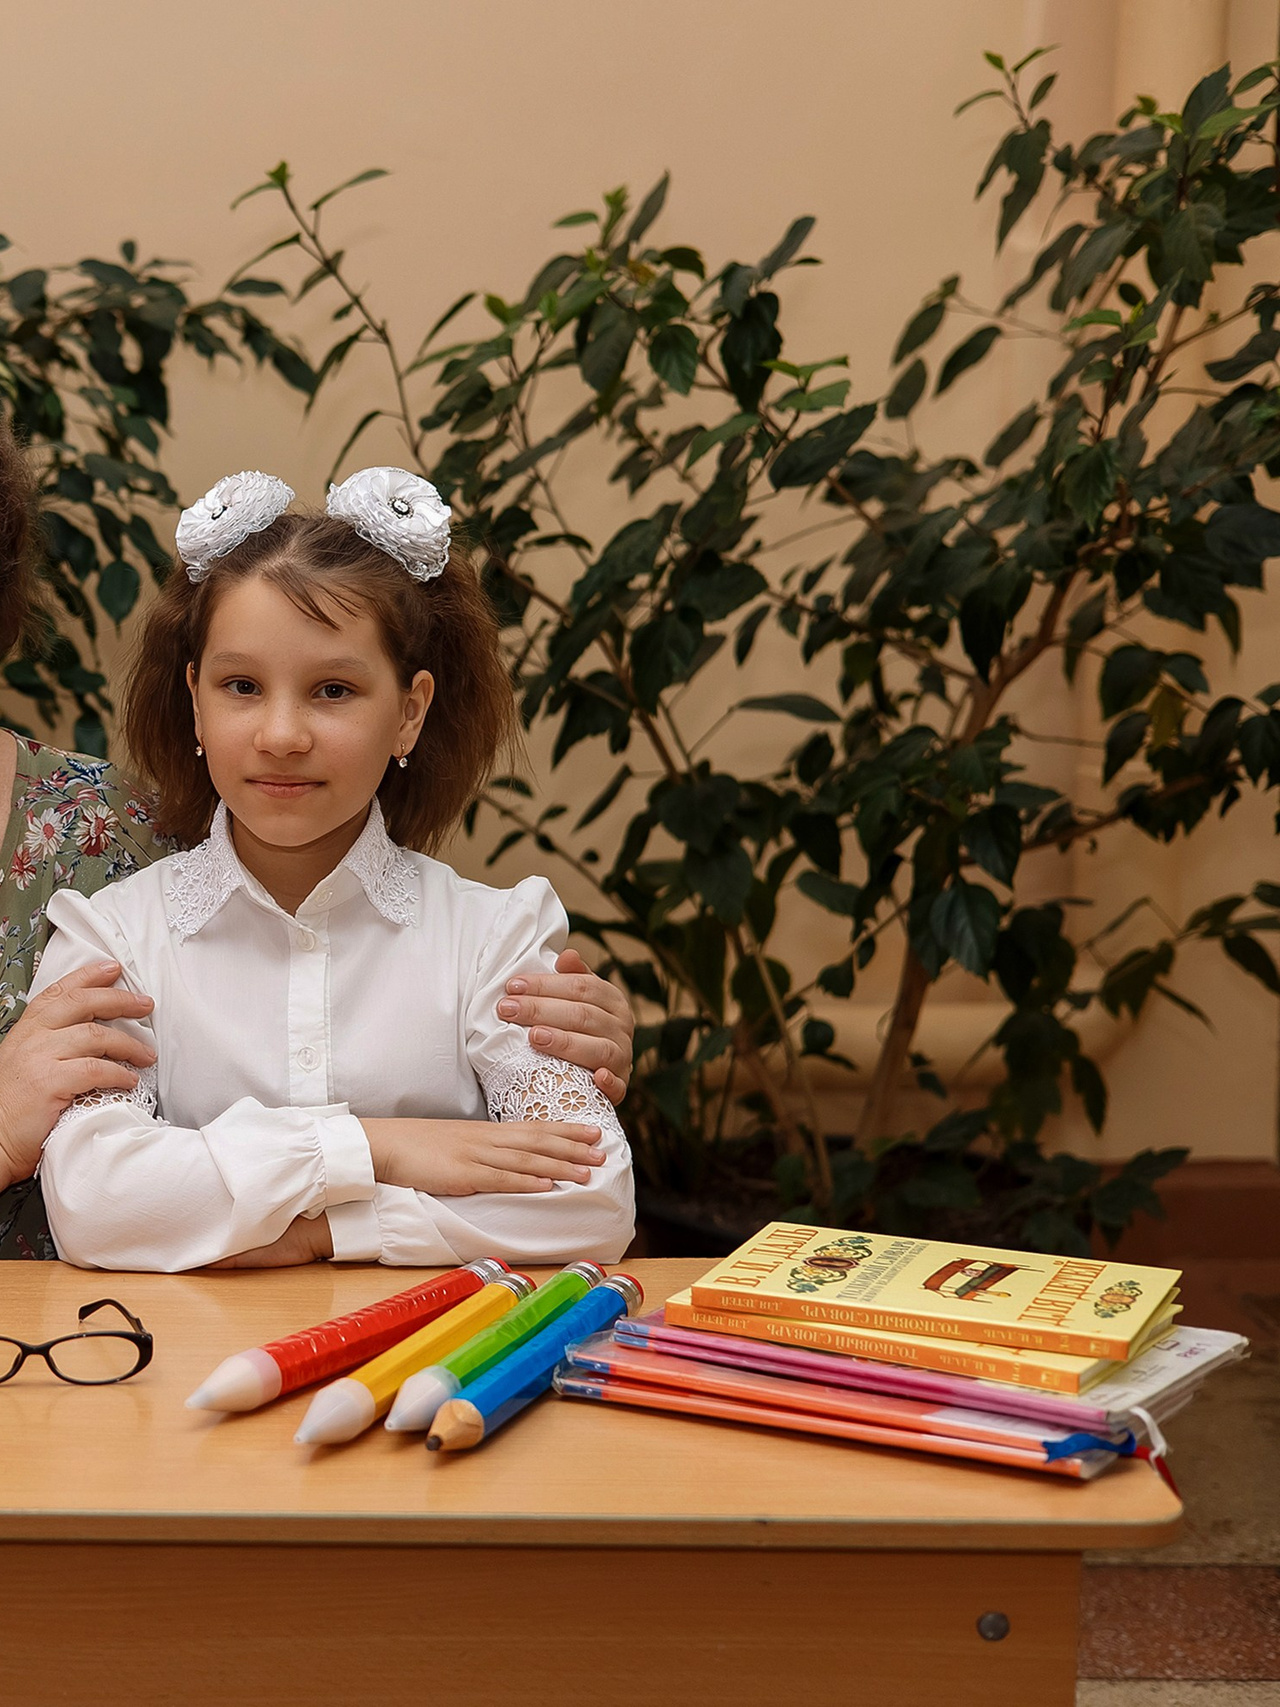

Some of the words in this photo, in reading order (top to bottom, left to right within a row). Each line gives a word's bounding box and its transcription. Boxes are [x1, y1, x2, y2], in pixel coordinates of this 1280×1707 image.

[748, 1228, 819, 1262] ДАЛЬ
[836, 1264, 890, 1299] ТОЛКОВЫЙ
[873, 1240, 917, 1265] СЛОВАРЬ
[1040, 1259, 1107, 1301] ДЕТЕЙ
[721, 1295, 757, 1310] ДЕТЕЙ
[759, 1299, 783, 1311] ДЛЯ
[1016, 1296, 1075, 1329] ДЛЯ
[691, 1312, 725, 1326] ДЕТЕЙ
[727, 1317, 750, 1329] ДЛЯ
[800, 1304, 869, 1324] СЛОВАРЬ
[766, 1322, 832, 1344] СЛОВАРЬ
[873, 1314, 961, 1336] ТОЛКОВЫЙ
[983, 1329, 1015, 1341] ДАЛЬ
[835, 1334, 917, 1360] ТОЛКОВЫЙ
[939, 1355, 970, 1368] ДАЛЬ
